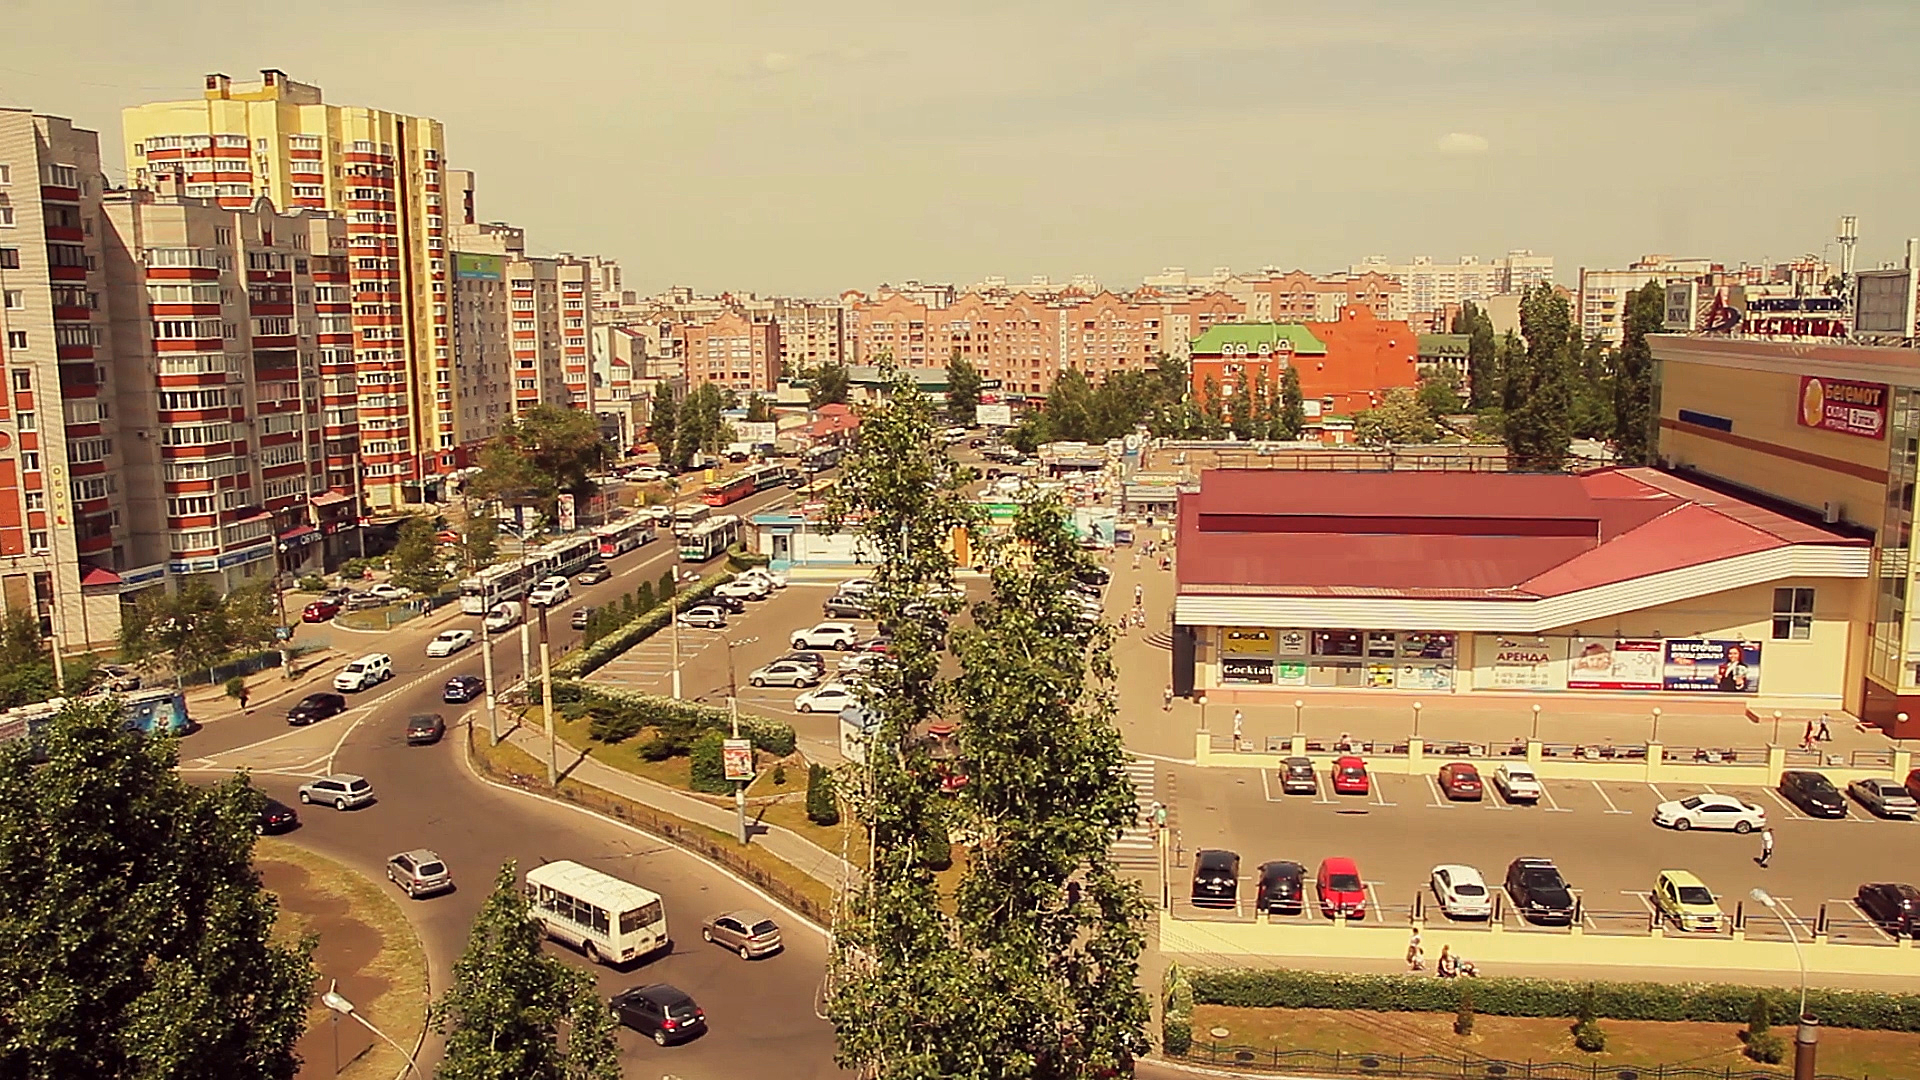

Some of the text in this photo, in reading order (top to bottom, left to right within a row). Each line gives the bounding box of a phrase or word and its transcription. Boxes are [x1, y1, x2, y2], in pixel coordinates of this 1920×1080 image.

[53, 467, 65, 510] ОБОИ
[1496, 652, 1550, 662] АРЕНДА
[1223, 665, 1273, 675] Cocktail
